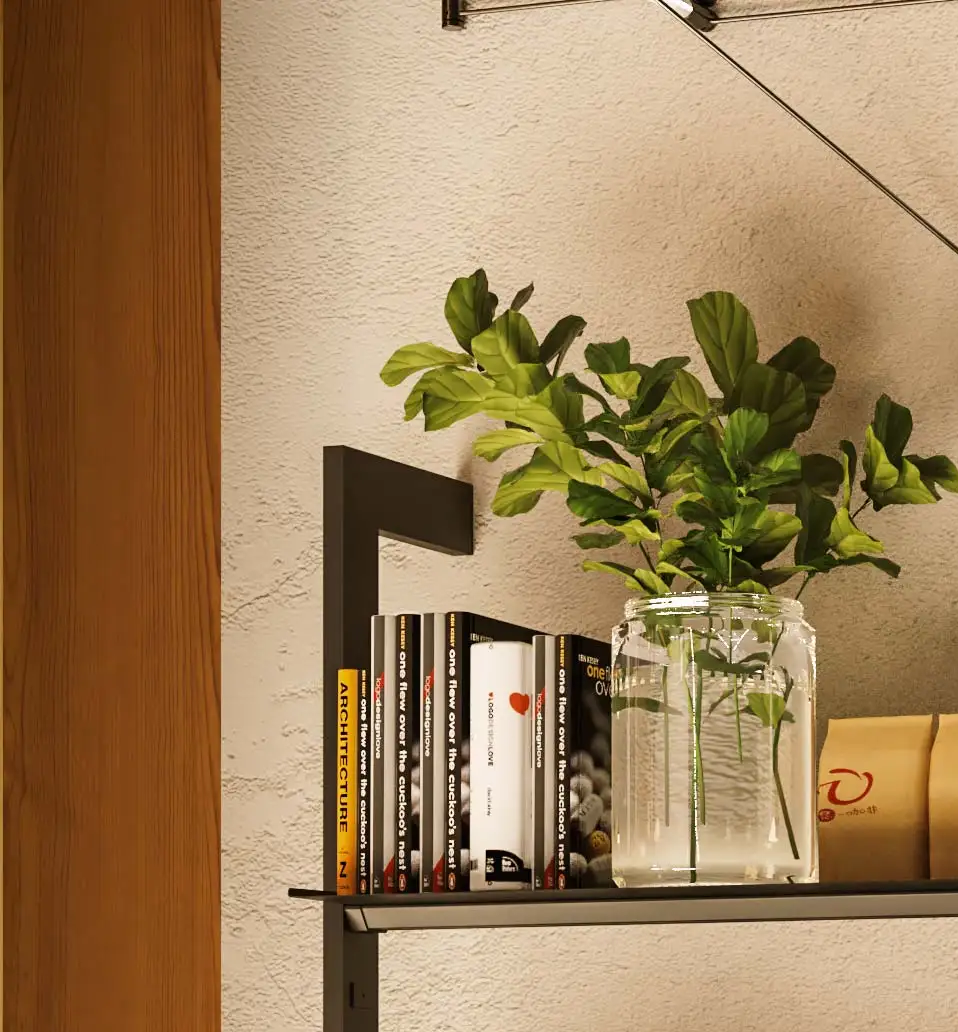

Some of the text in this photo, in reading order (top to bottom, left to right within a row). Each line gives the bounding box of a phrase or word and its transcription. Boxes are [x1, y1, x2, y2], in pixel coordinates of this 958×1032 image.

[374, 678, 382, 758] logodesignlove
[423, 676, 432, 757] logodesignlove
[535, 694, 543, 768] logodesignlove
[587, 665, 605, 680] one
[339, 682, 349, 832] ARCHITECTURE
[360, 699, 368, 876] one flew over the cuckoo's nest
[398, 652, 408, 870] one flew over the cuckoo's nest
[448, 649, 458, 869] one flew over the cuckoo's nest
[558, 669, 568, 871] one flew over the cuckoo's nest
